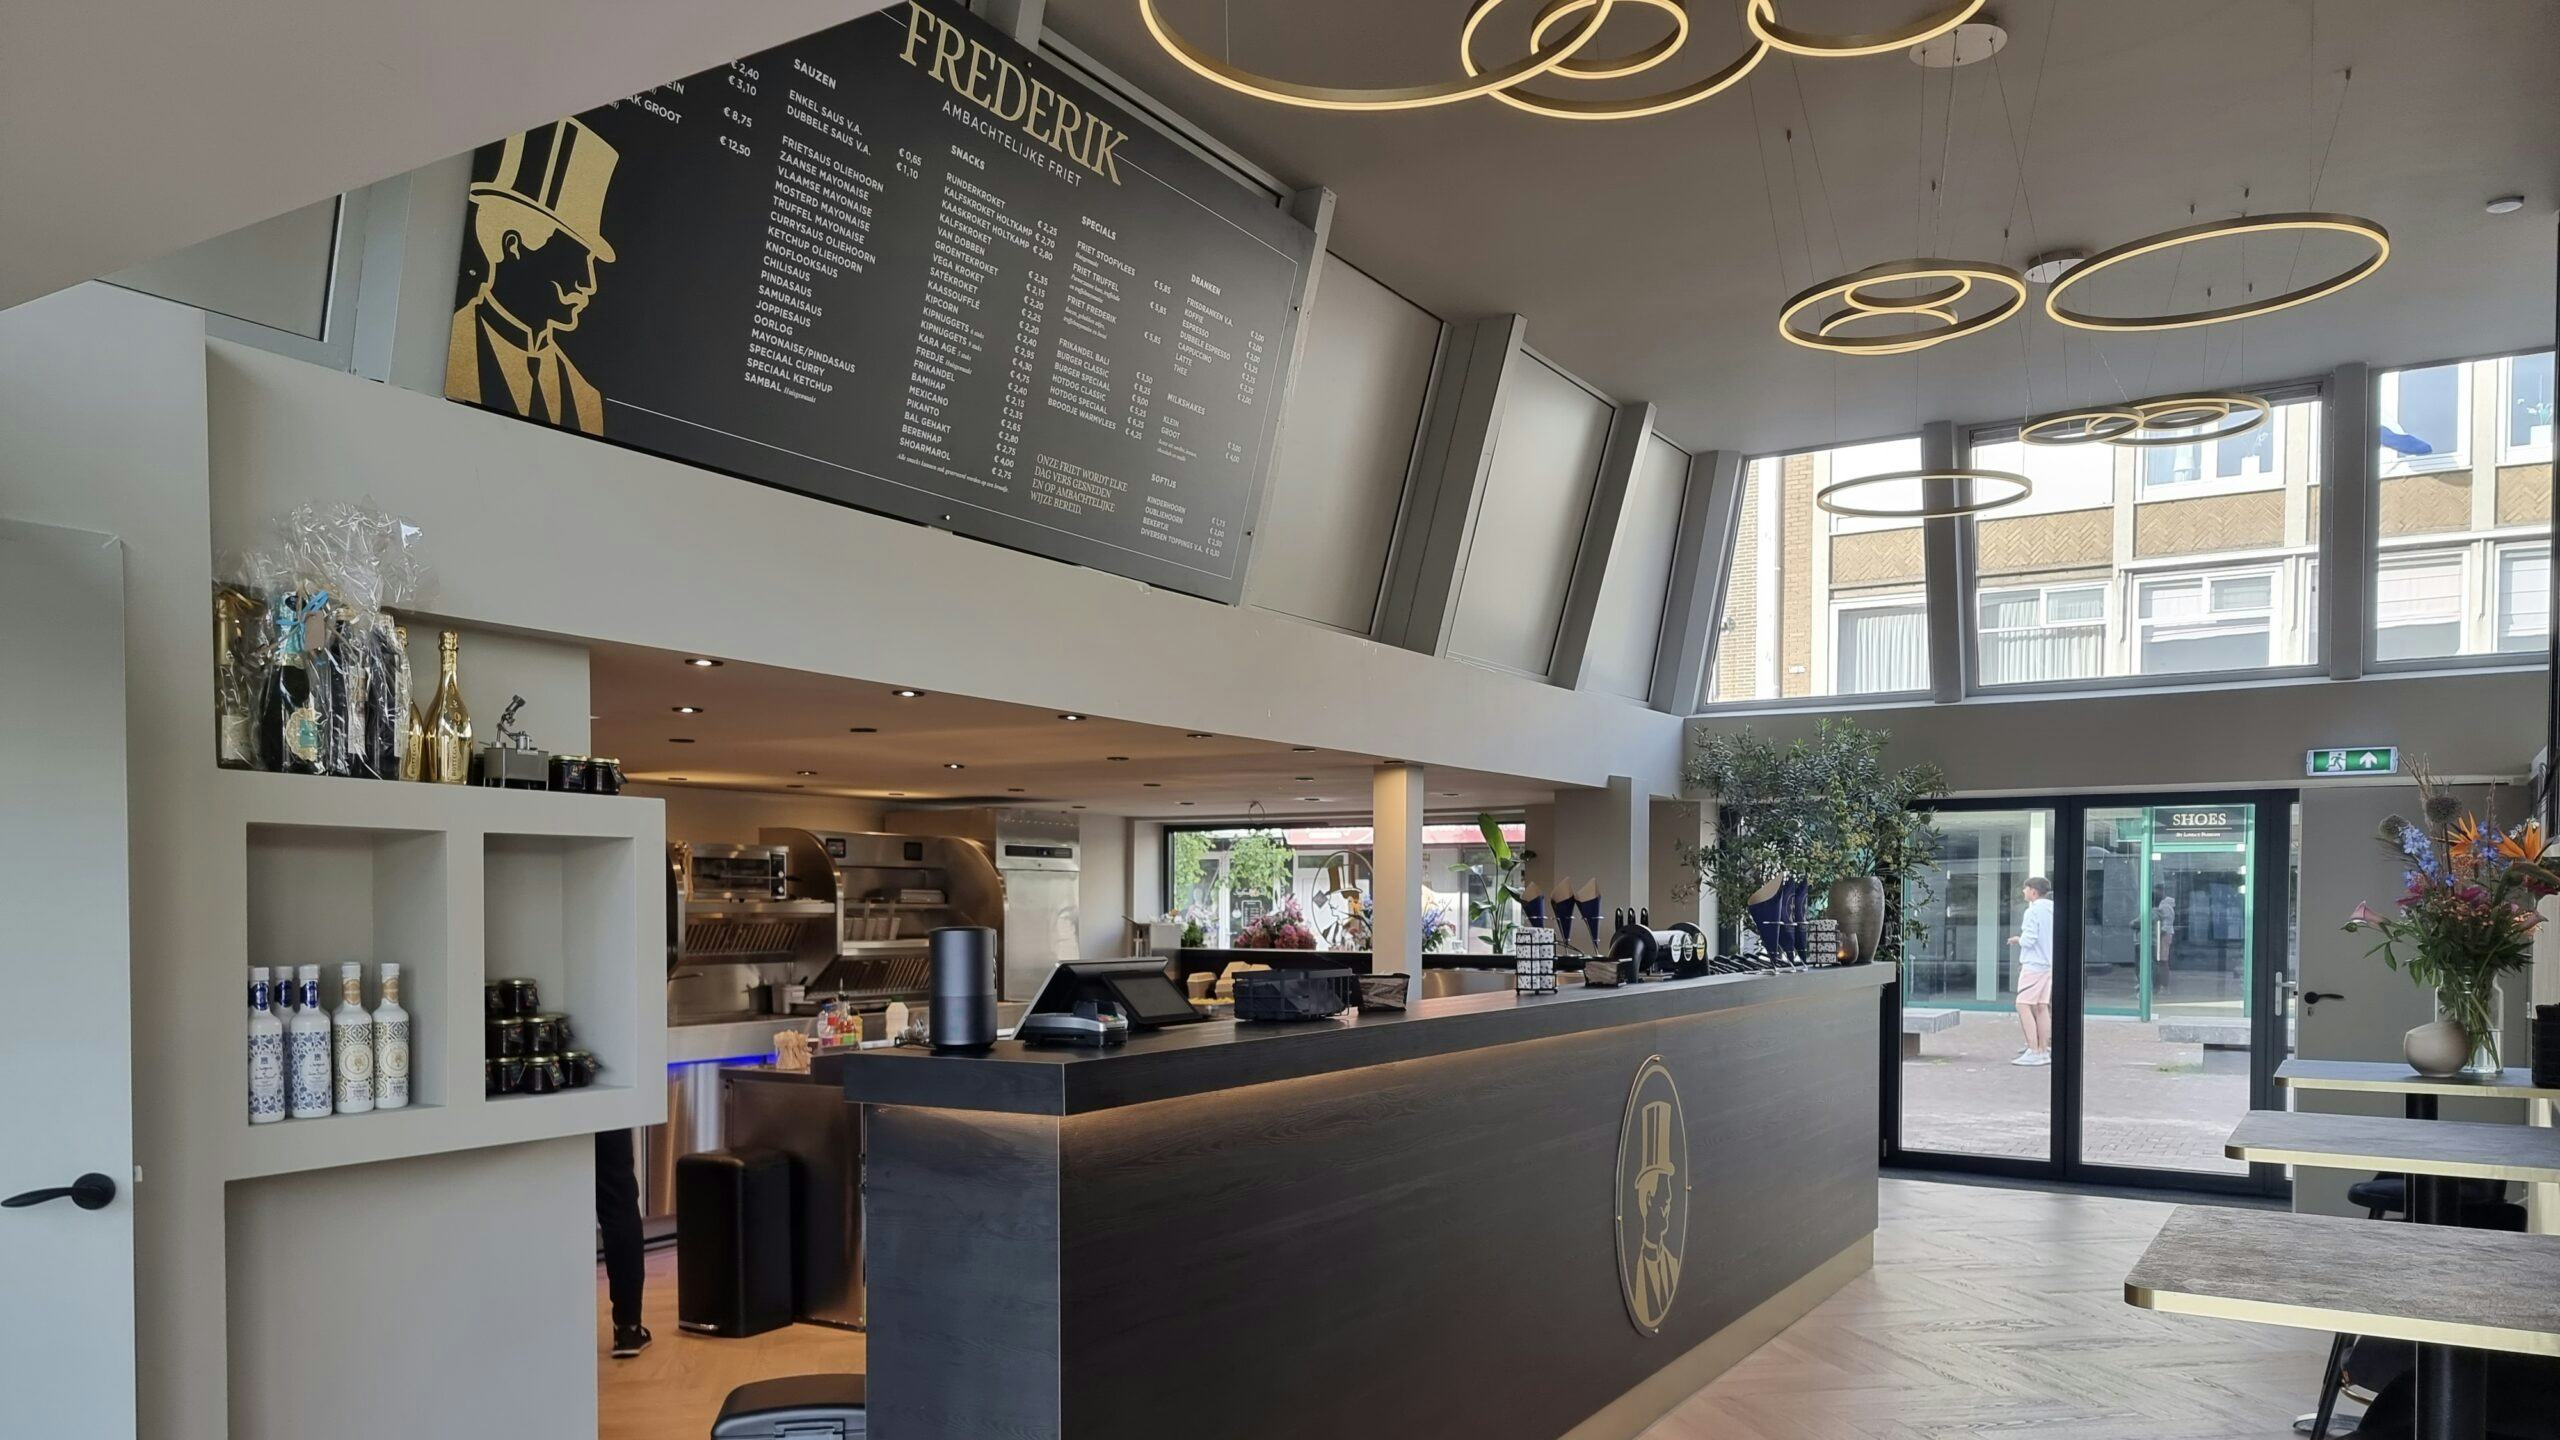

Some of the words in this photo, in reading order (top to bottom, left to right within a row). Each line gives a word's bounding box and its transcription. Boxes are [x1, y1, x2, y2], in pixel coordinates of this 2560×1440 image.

[739, 63, 759, 80] 2,40
[793, 58, 836, 89] SAUZEN
[736, 78, 756, 96] 3,10
[900, 0, 1129, 186] FREDERIK
[644, 99, 681, 124] GROOT
[732, 110, 752, 127] 8,75
[789, 89, 818, 113] ENKEL
[821, 106, 844, 125] SAUS
[846, 119, 862, 135] V.A.
[728, 138, 750, 157] 12,50
[830, 127, 853, 146] SAUS
[855, 139, 871, 156] V.A.
[942, 100, 1045, 167] AMBACHTELIJKE
[1048, 159, 1081, 186] FRIET
[782, 135, 831, 166] FRIETSAUS
[833, 160, 883, 192] OLIEHOORN
[905, 151, 922, 166] 0,65
[950, 144, 985, 170] SNACKS
[779, 150, 817, 176] ZAANSE
[819, 169, 869, 201] MAYONAISE
[903, 164, 918, 179] 1,10
[778, 165, 821, 193] VLAAMSE
[822, 186, 872, 217] MAYONAISE
[946, 172, 1005, 209] RUNDERKROKET
[775, 180, 818, 207] MOSTERD
[820, 201, 870, 232] MAYONAISE
[944, 185, 995, 218] KALFSKROKET
[995, 212, 1032, 236] HOLTKAMP
[773, 195, 812, 221] TRUFFEL
[814, 214, 865, 244] MAYONAISE
[939, 212, 992, 244] KALFSKROKET
[941, 199, 991, 230] KAASKROKET
[991, 224, 1029, 248] HOLTKAMP
[1042, 222, 1057, 236] 2,25
[1081, 215, 1116, 240] SPECIALS
[767, 225, 810, 249] KETCHUP
[811, 244, 862, 273] OLIEHOORN
[770, 211, 823, 241] CURRYSAUS
[825, 235, 876, 264] OLIEHOORN
[937, 226, 953, 240] VAN
[954, 234, 985, 256] DOBBEN
[1040, 235, 1055, 248] 2,70
[765, 240, 838, 278] KNOFLOOKSAUS
[934, 240, 998, 276] GROENTEKROKET
[1038, 247, 1053, 261] 2,80
[1076, 240, 1096, 255] FRIET
[1095, 250, 1135, 276] STOOFVLEES
[763, 255, 810, 281] CHILISAUS
[933, 253, 952, 269] VEGA
[954, 263, 984, 283] KROKET
[1072, 262, 1091, 277] FRIET
[1092, 272, 1119, 292] TRUFFEL
[760, 269, 812, 297] PINDASAUS
[927, 280, 980, 310] KAASSOUFFLÉ
[1031, 285, 1045, 298] 2,15
[1191, 274, 1221, 296] DRANKEN
[758, 284, 822, 316] SAMURAISAUS
[925, 293, 959, 314] KIPCORN
[1066, 294, 1085, 309] FRIET
[1086, 303, 1117, 324] FREDERIK
[753, 314, 793, 335] OORLOG
[755, 299, 811, 327] JOPPIESAUS
[922, 306, 969, 332] KIPNUGGETS
[920, 319, 967, 345] KIPNUGGETS
[1182, 319, 1209, 338] ESPRESSO
[751, 328, 855, 373] MAYONAISE/PINDASAUS
[915, 345, 944, 364] FREDJE
[918, 332, 939, 348] KARA
[940, 342, 957, 355] AGE
[1019, 347, 1035, 359] 2,95
[1058, 337, 1094, 359] FRIKANDEL
[1204, 342, 1230, 360] ESPRESSO
[749, 343, 793, 366] SPECIAAL
[795, 359, 825, 376] CURRY
[913, 358, 955, 382] FRIKANDEL
[1056, 349, 1082, 367] BURGER
[1083, 361, 1109, 378] CLASSIC
[1173, 363, 1187, 376] THEE
[1175, 352, 1192, 366] LATTE
[744, 371, 781, 392] SAMBAL
[746, 357, 790, 380] SPECIAAL
[793, 372, 832, 393] KETCHUP
[911, 372, 945, 390] BAMIHAP
[1015, 372, 1030, 383] 4,75
[1052, 373, 1079, 391] HOTDOG
[1080, 385, 1106, 401] CLASSIC
[1054, 361, 1080, 378] BURGER
[1081, 373, 1110, 391] SPECIAAL
[906, 398, 939, 416] PIKANTO
[908, 384, 948, 406] MEXICANO
[1047, 397, 1078, 415] BROODJE
[1049, 385, 1077, 402] HOTDOG
[1077, 396, 1107, 414] SPECIAAL
[1167, 393, 1205, 415] MILKSHAKES
[903, 411, 919, 423] BAL
[920, 417, 951, 433] GEHAKT
[1008, 408, 1023, 420] 2,35
[1162, 415, 1179, 427] KLEIN
[901, 423, 942, 443] BERENHAP
[1004, 432, 1018, 444] 2,80
[1160, 426, 1180, 439] GROOT
[899, 437, 950, 460] SHOARMAROL
[997, 468, 1012, 479] 2,75
[999, 457, 1014, 467] 4,00
[1036, 453, 1059, 469] ONZE
[1059, 460, 1082, 476] FRIET
[1082, 468, 1109, 485] WORDT
[1109, 477, 1128, 492] ELKE
[1034, 465, 1051, 479] DAG
[1052, 471, 1072, 486] VERS
[1072, 478, 1111, 498] GESNEDEN
[1151, 473, 1176, 488] SOFTIJS
[1030, 490, 1053, 505] WIJZE
[1031, 477, 1044, 489] EN
[1044, 482, 1056, 493] OP
[1055, 486, 1115, 512] AMBACHTELIJKE
[2172, 813, 2227, 826] SHOES
